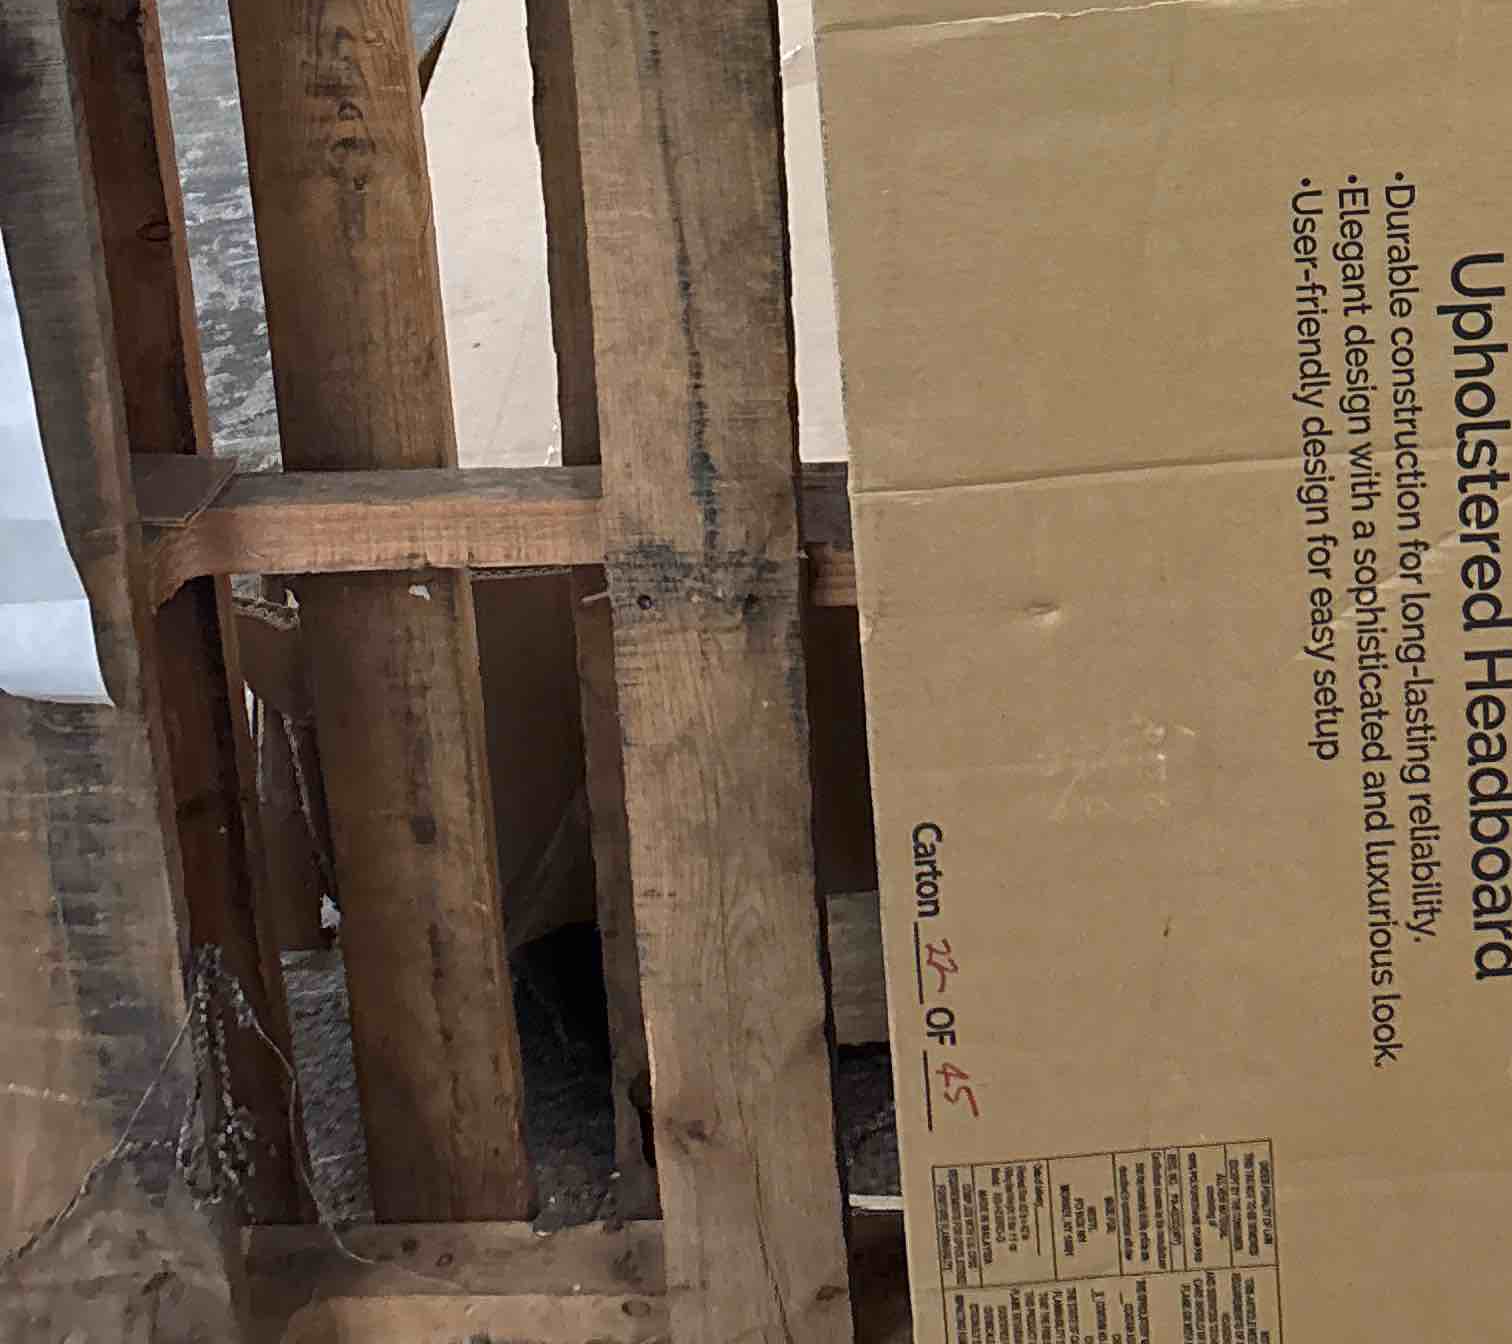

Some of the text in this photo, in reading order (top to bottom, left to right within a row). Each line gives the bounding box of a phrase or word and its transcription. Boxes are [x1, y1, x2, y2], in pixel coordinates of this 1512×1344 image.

[1338, 324, 1378, 435] design
[1390, 326, 1428, 531] construction
[1295, 416, 1336, 526] design
[1348, 441, 1382, 512] with
[1306, 533, 1339, 580] for
[1351, 519, 1376, 541] a
[1397, 538, 1431, 585] for
[1303, 587, 1336, 663] easy
[1346, 548, 1393, 763] sophisticated
[1307, 669, 1345, 761] setup
[1394, 592, 1438, 785] long-lasting
[1362, 771, 1396, 833] and
[912, 822, 943, 918] Carton
[1404, 793, 1443, 943] reliability.
[1365, 839, 1399, 987] luxurious
[925, 1007, 957, 1046] OF
[1371, 994, 1404, 1068] look.
[936, 1063, 980, 1118] 45
